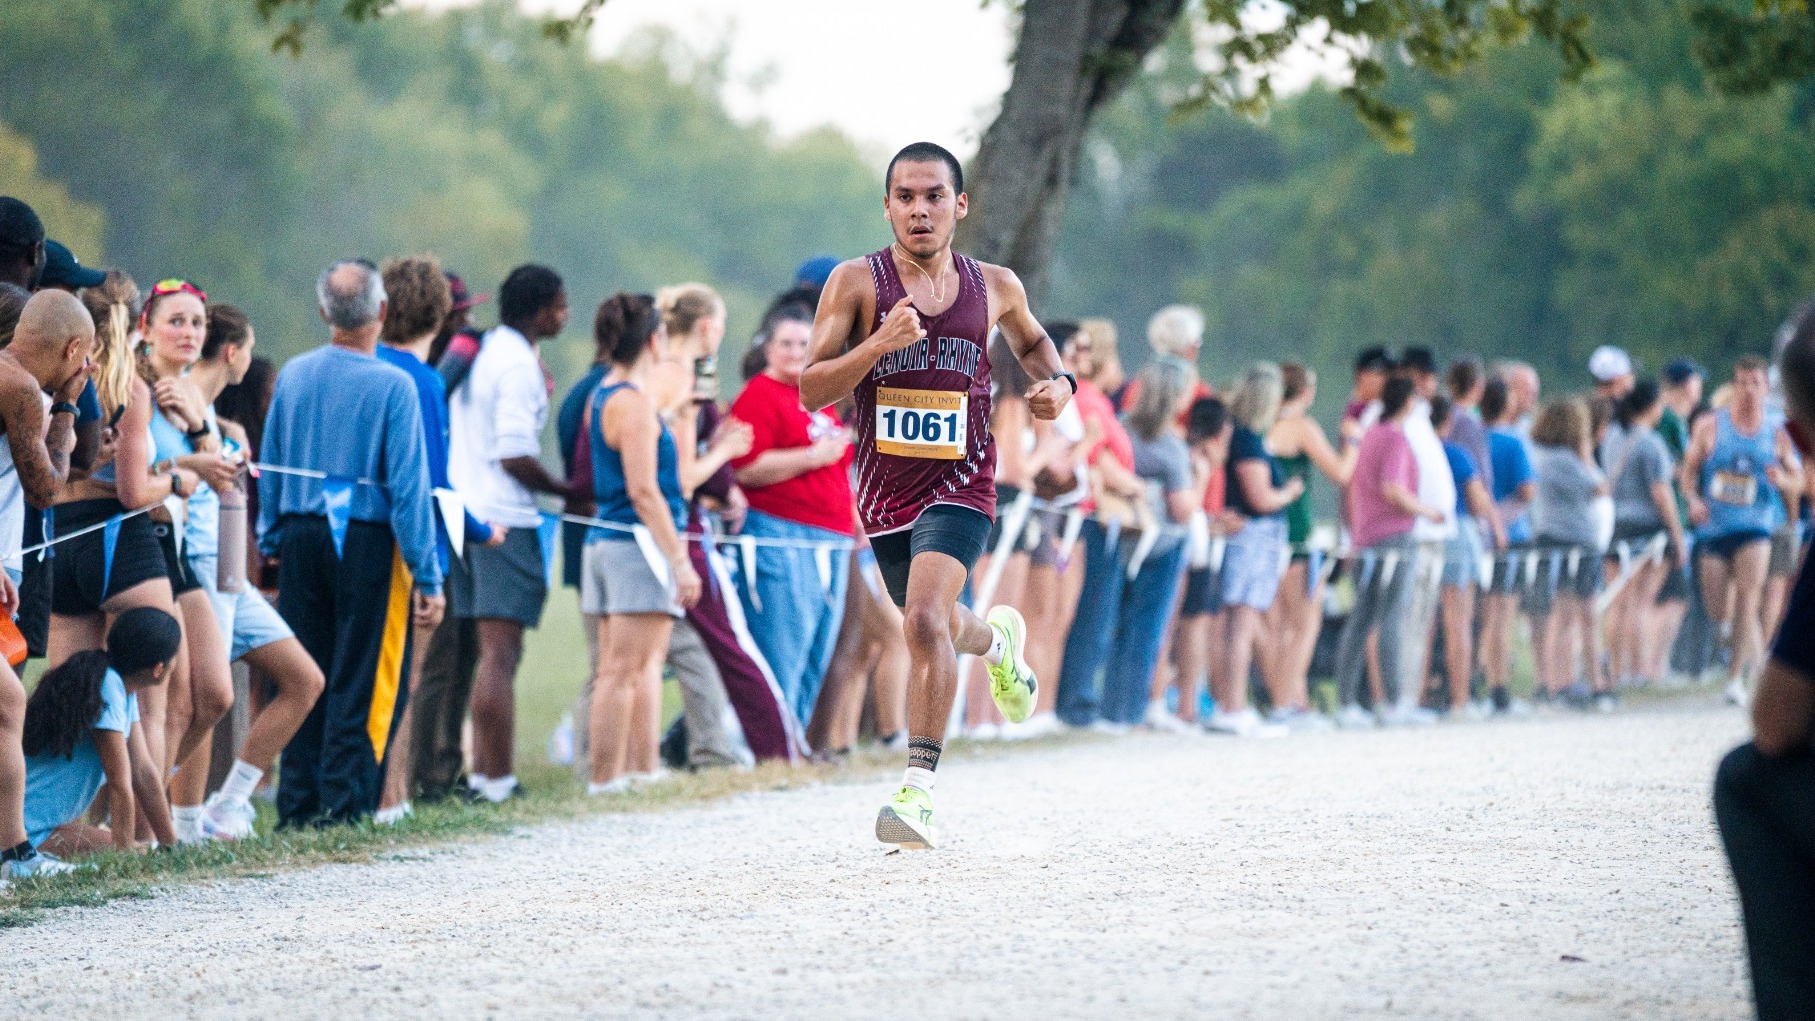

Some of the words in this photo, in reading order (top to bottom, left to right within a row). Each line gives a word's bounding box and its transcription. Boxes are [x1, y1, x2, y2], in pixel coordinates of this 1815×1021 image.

[878, 393, 910, 403] QUEEN
[914, 395, 935, 404] CITY
[882, 409, 958, 443] 1061
